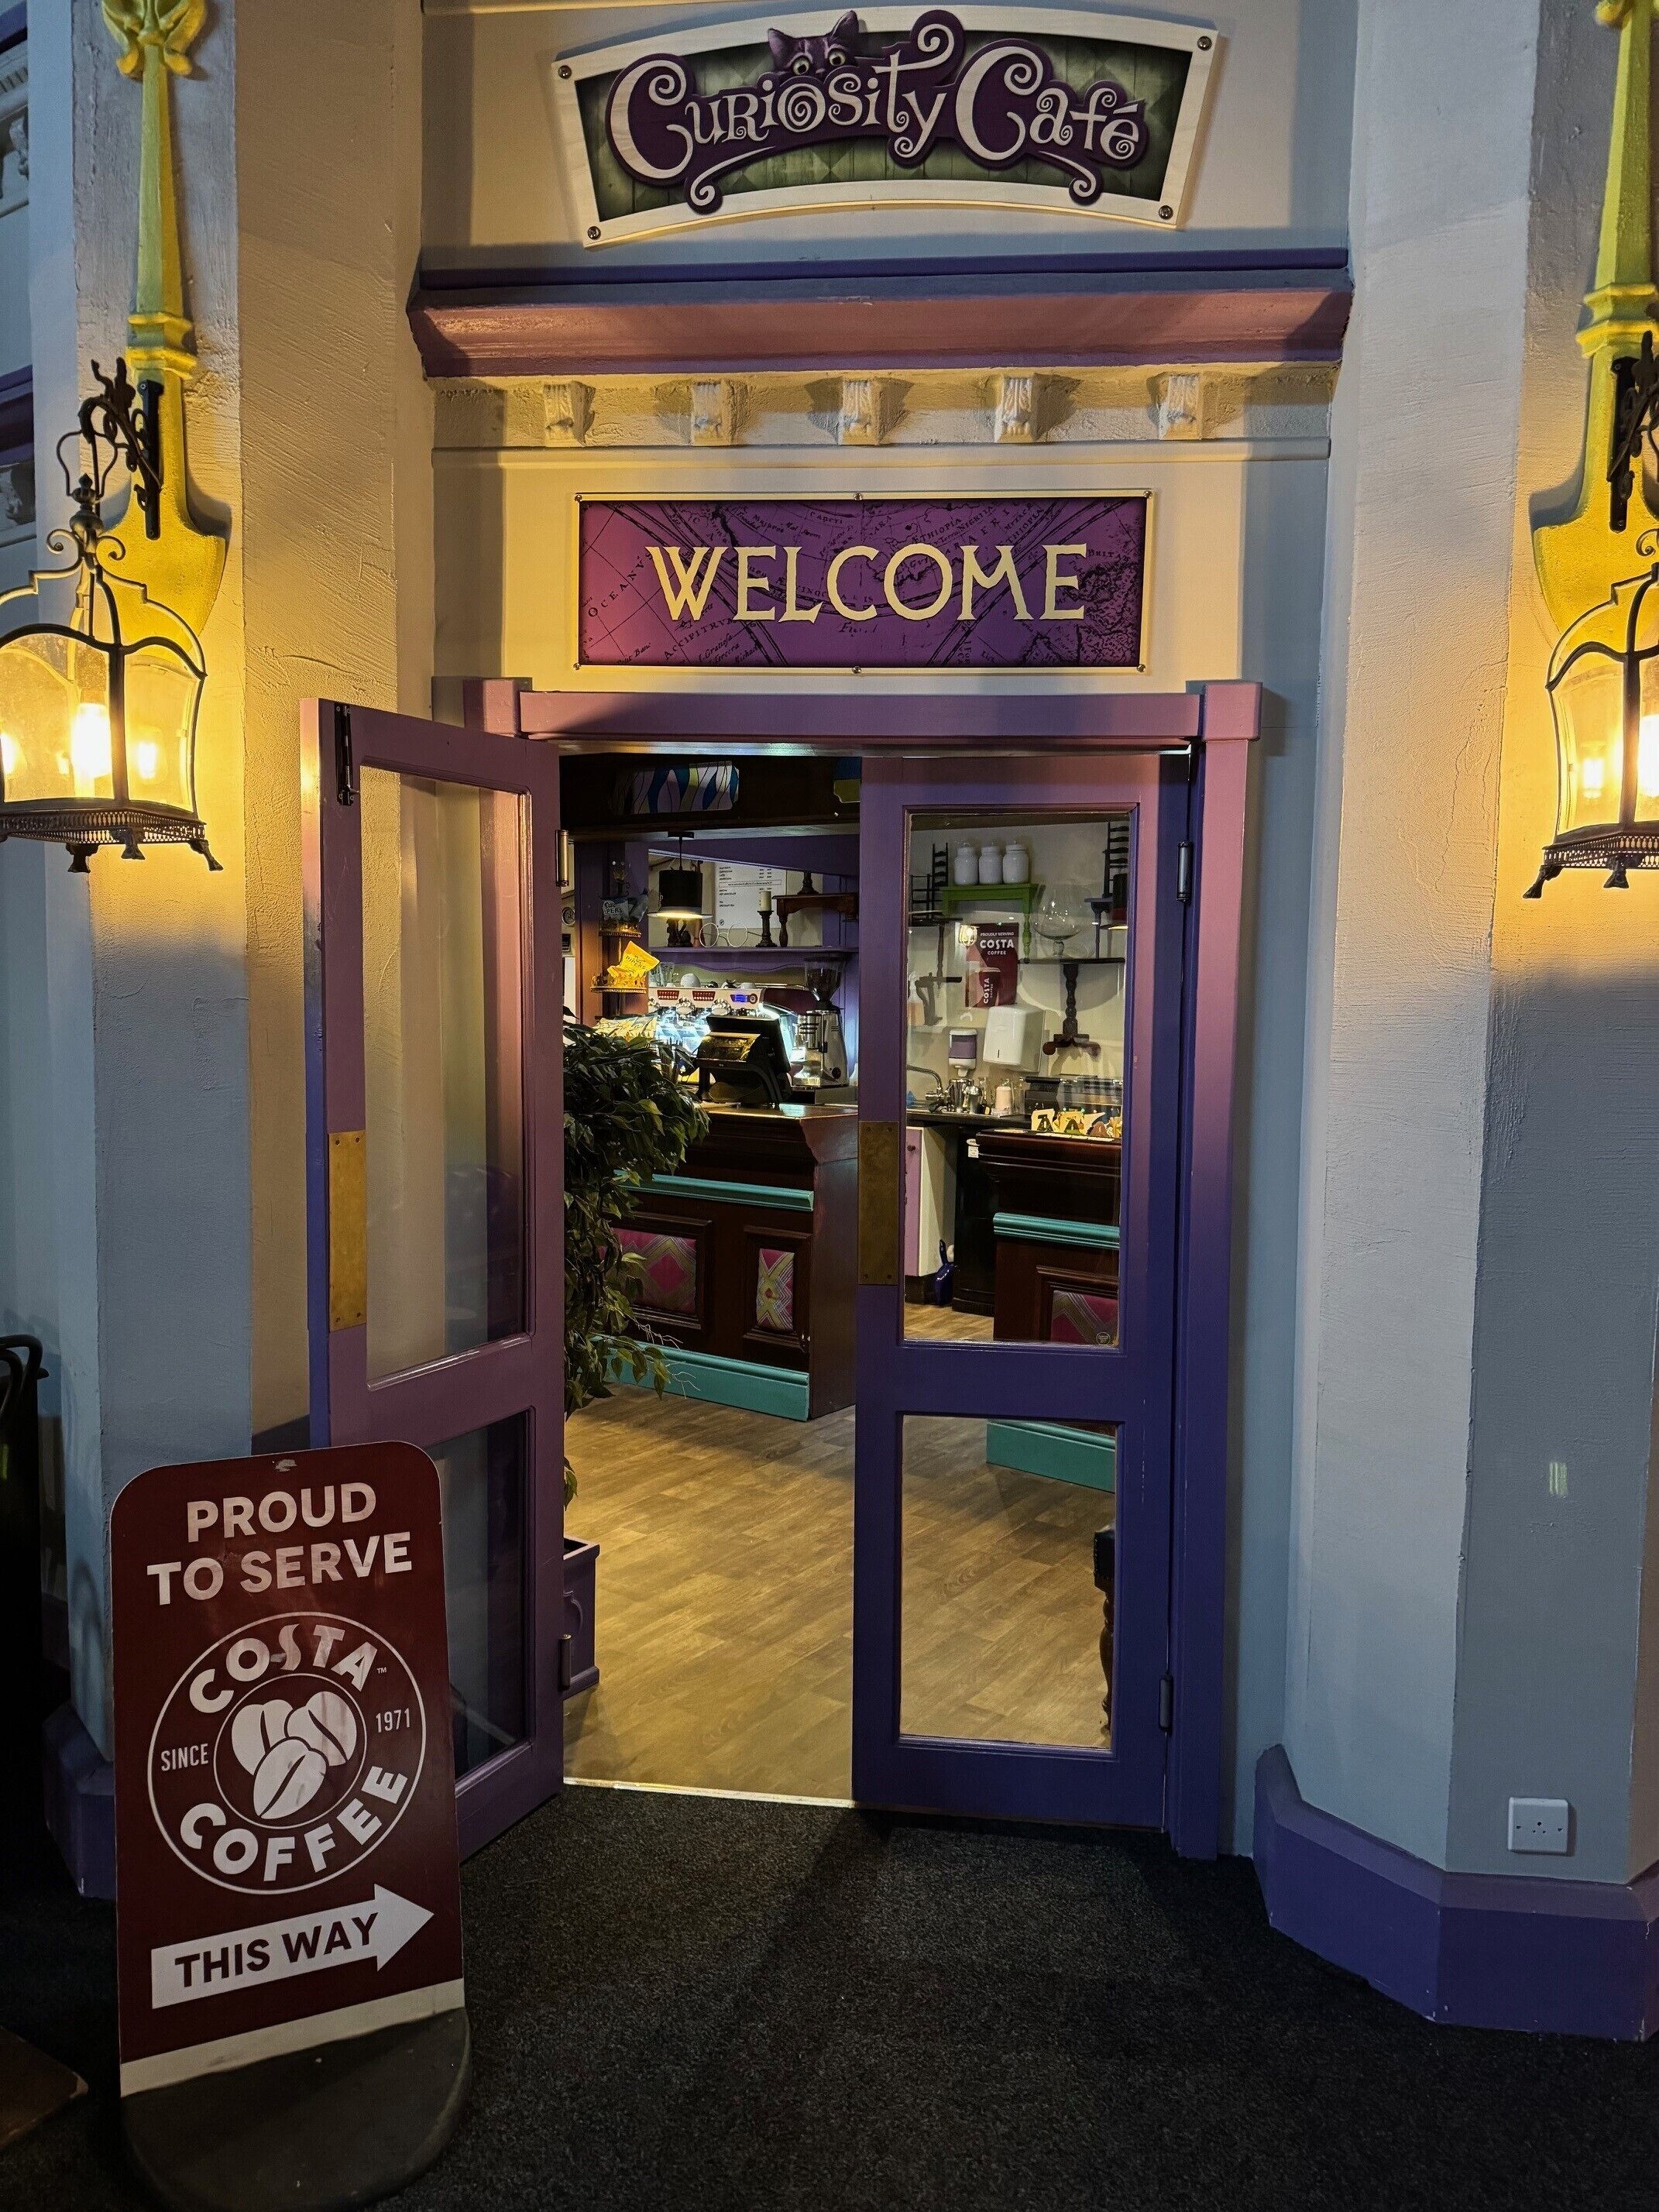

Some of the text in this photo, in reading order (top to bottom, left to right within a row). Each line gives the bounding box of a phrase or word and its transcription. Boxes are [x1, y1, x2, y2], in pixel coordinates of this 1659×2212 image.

[956, 46, 1139, 161] Café
[644, 542, 1087, 624] WELCOME
[979, 939, 1015, 950] COSTA
[187, 1482, 376, 1543] PROUD
[146, 1531, 413, 1606] TO SERVE
[189, 1623, 379, 1713] COSTA
[160, 1708, 412, 1772] SINCE 1971
[180, 1765, 408, 1882] COFFEE
[174, 1911, 379, 1988] THIS WAY
